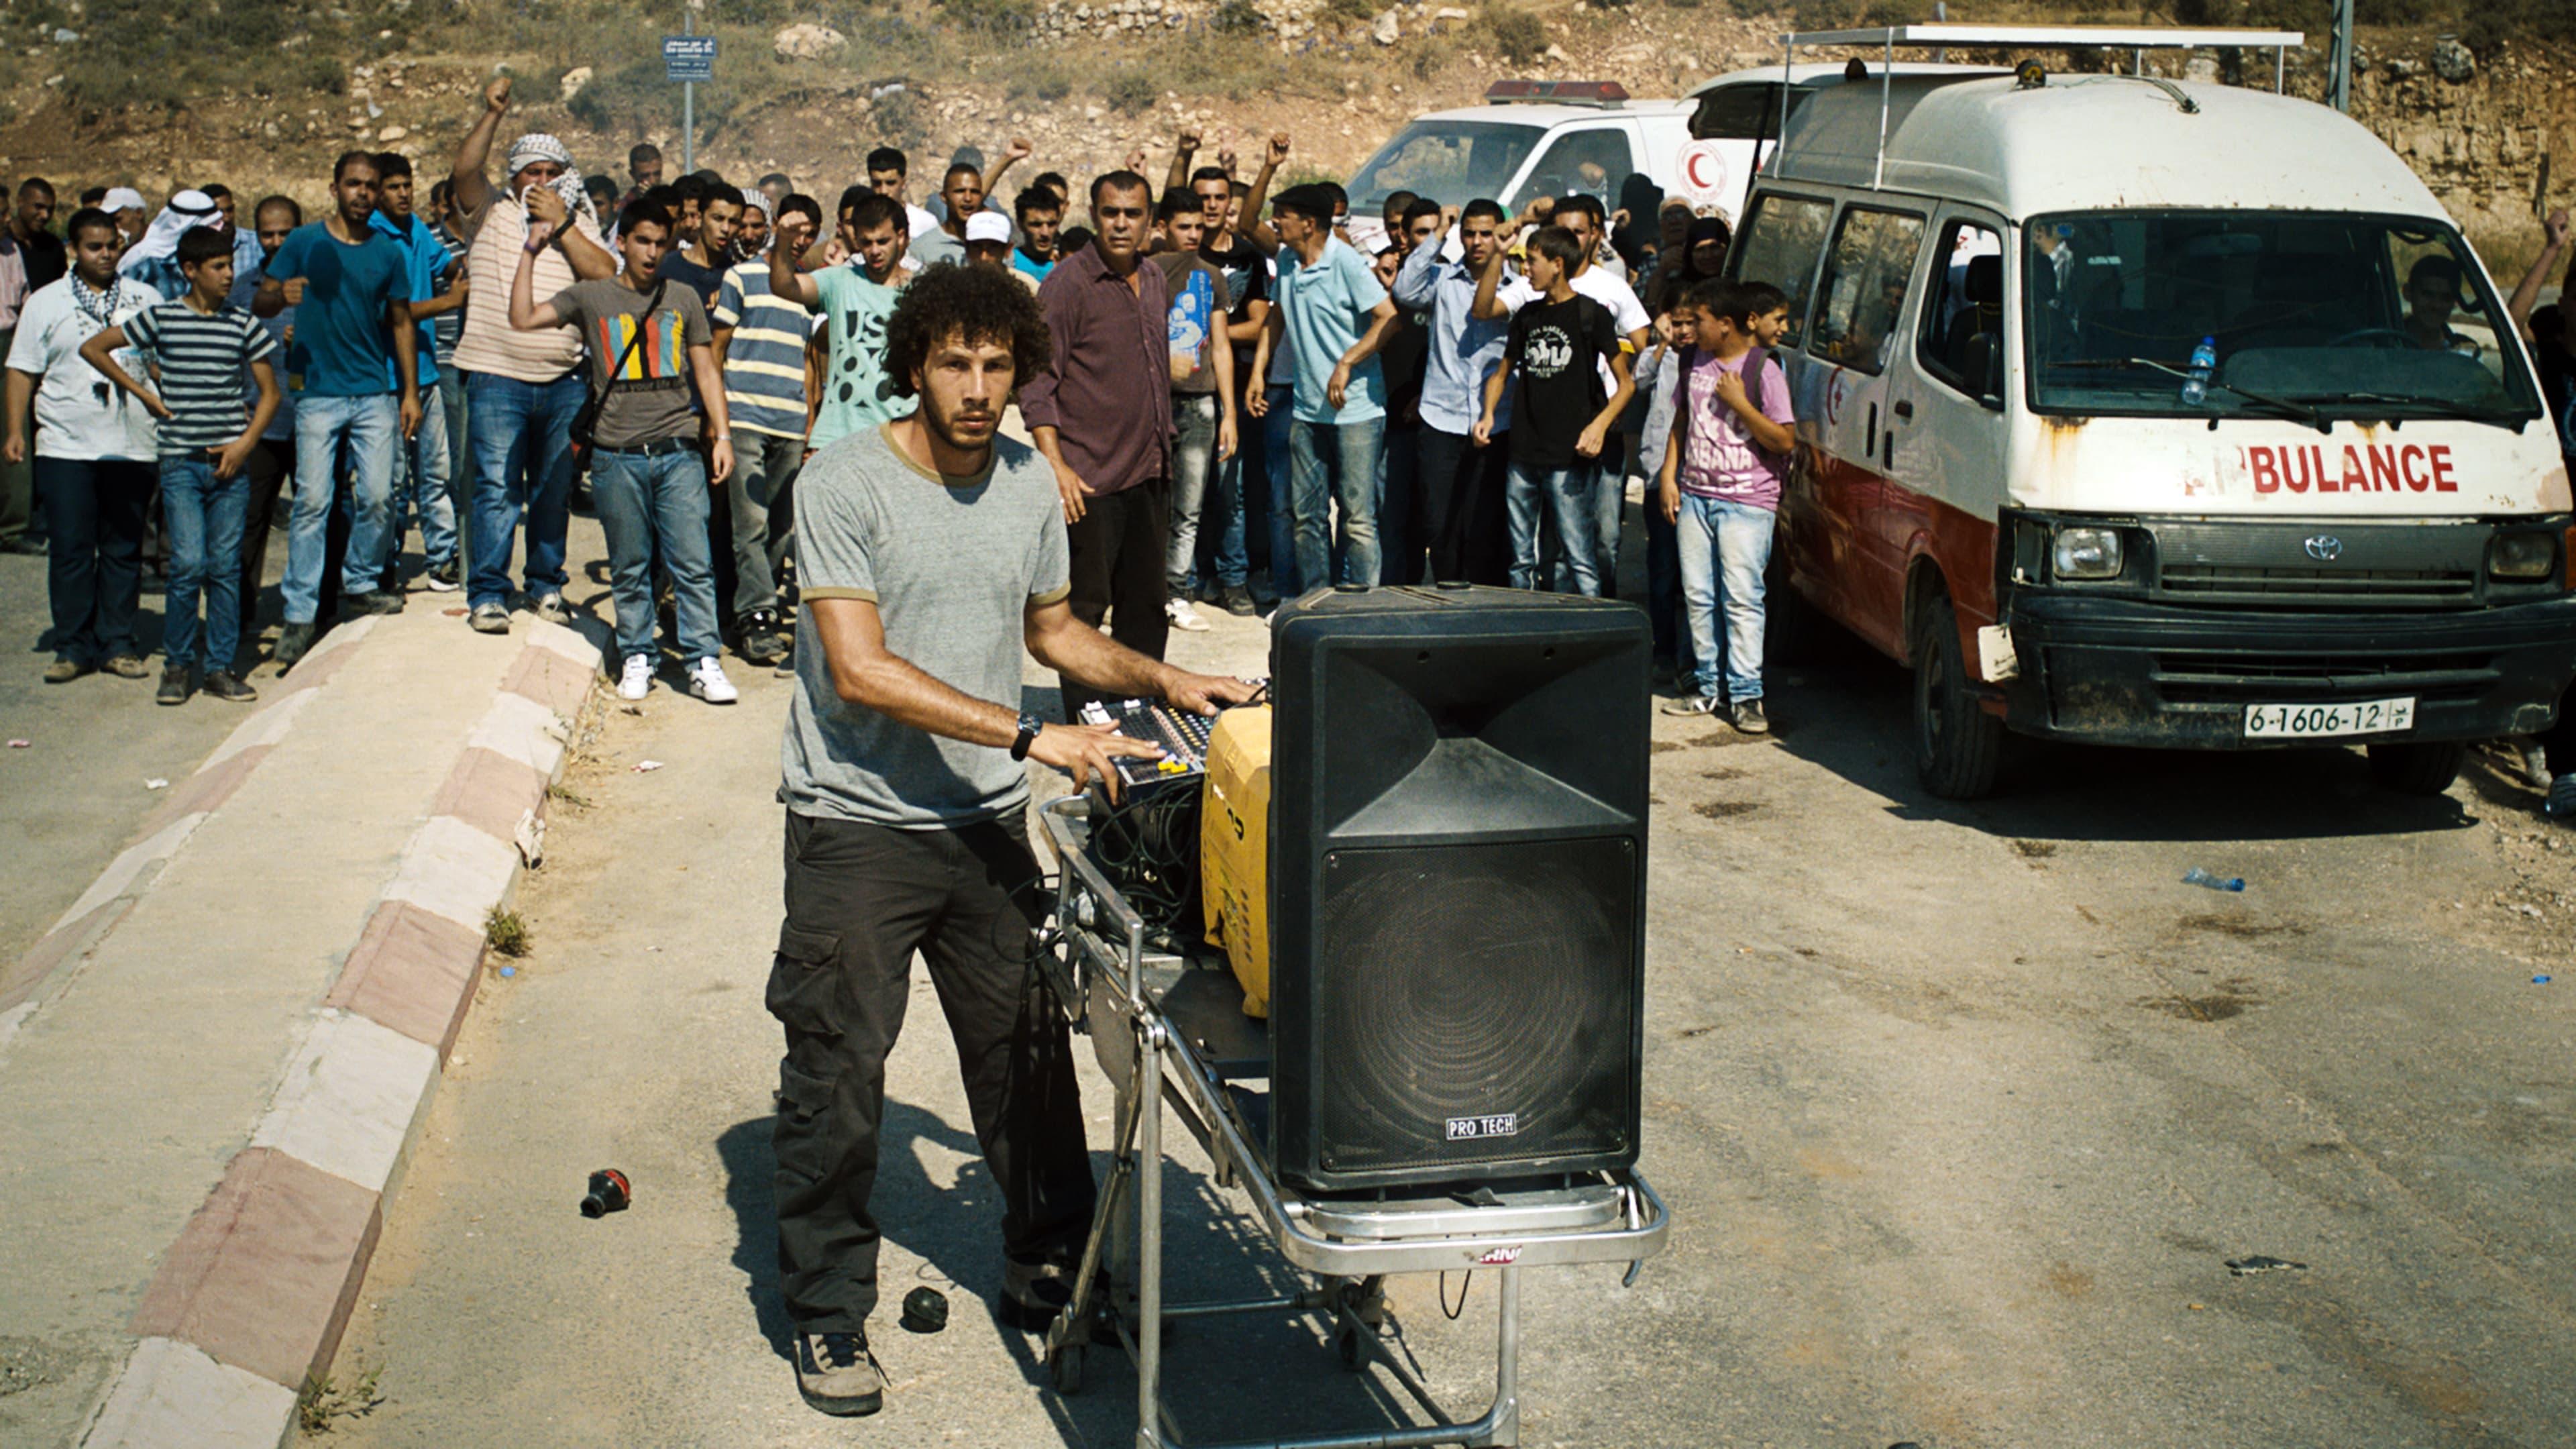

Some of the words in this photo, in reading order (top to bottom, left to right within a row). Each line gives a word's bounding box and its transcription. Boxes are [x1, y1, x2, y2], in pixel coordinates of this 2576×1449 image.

[2239, 443, 2459, 493] BULANCE
[2250, 704, 2380, 732] 6-1606-12
[1449, 1120, 1477, 1136] PRO
[1481, 1117, 1513, 1134] TECH
